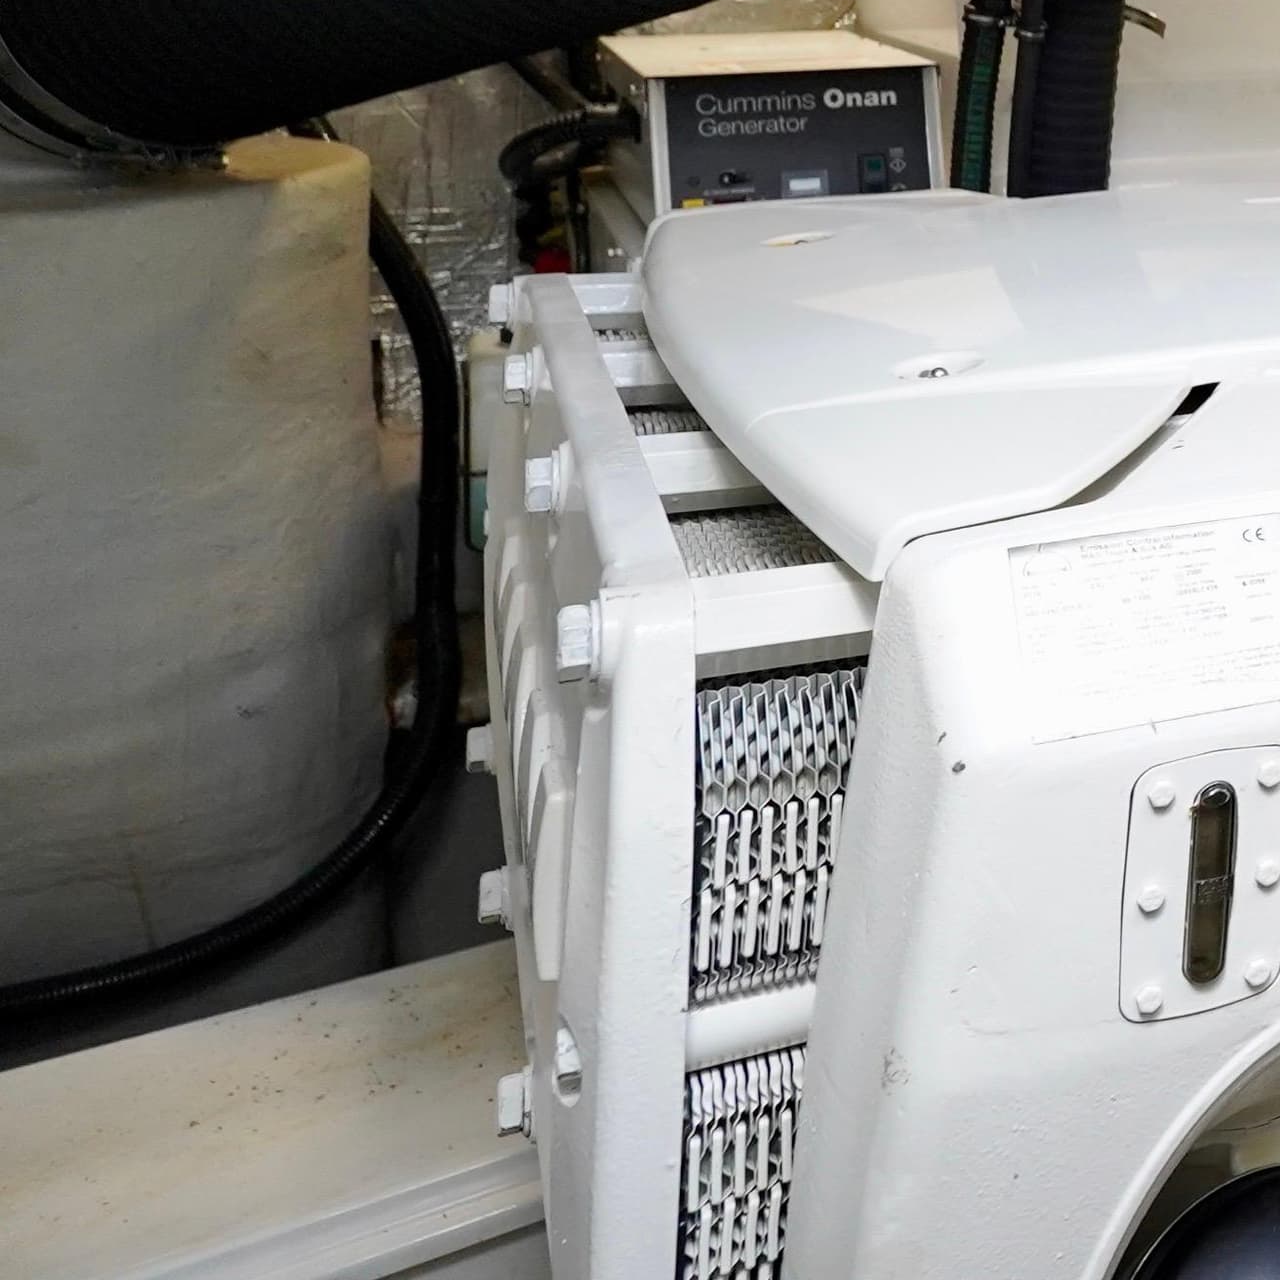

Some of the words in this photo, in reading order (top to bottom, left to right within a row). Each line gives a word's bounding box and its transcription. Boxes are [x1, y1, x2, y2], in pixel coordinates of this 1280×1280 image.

[695, 90, 816, 116] Cummins
[823, 88, 898, 109] Onan
[698, 116, 808, 137] Generator
